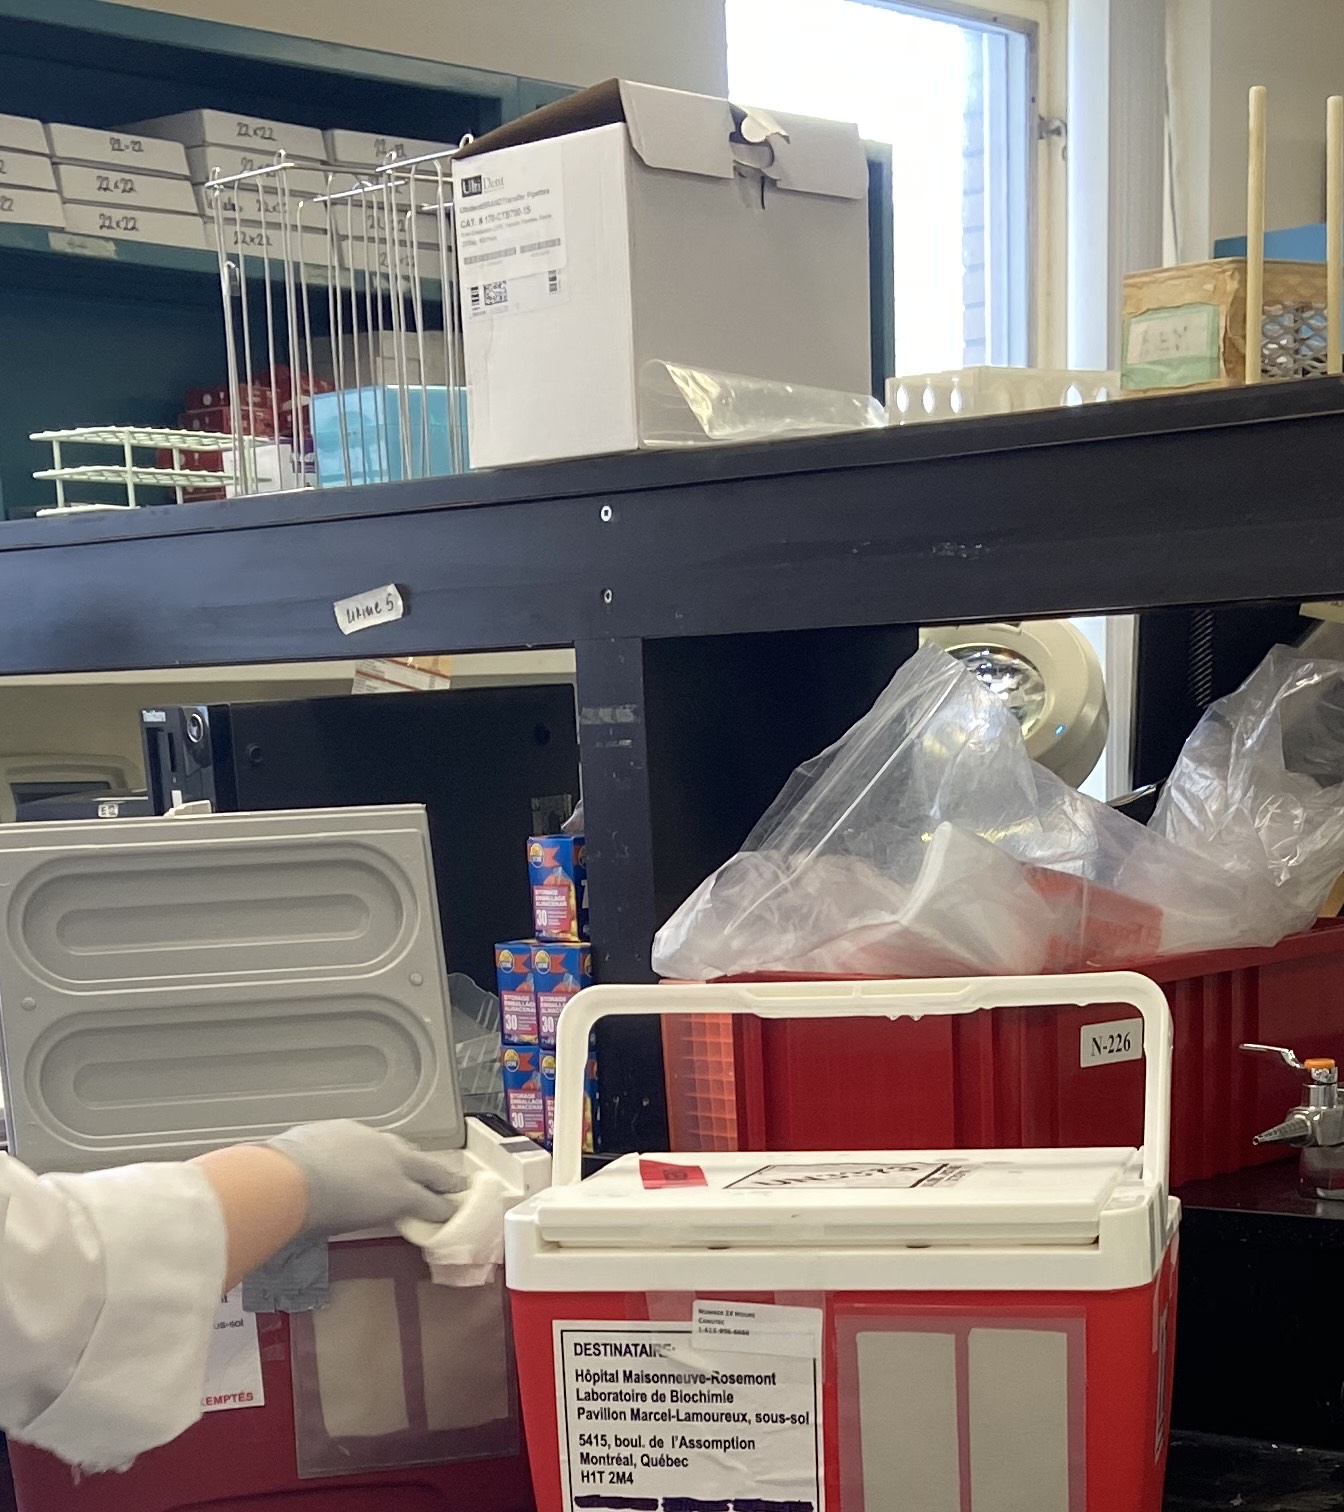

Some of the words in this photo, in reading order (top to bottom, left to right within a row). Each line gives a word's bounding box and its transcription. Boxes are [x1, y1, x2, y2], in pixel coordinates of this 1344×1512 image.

[1090, 1032, 1131, 1057] N-226
[575, 1368, 619, 1386] Hôpital
[622, 1370, 776, 1386] Maisonneuve-Rosemont
[576, 1387, 647, 1403] Laboratoire
[651, 1389, 666, 1403] de
[670, 1389, 734, 1404] Biochimie
[577, 1406, 627, 1421] Pavillon
[630, 1408, 751, 1425] Marcel-Lamoureux,
[755, 1411, 809, 1425] sous-sol
[579, 1433, 611, 1450] 5415,
[614, 1434, 645, 1448] boul.
[649, 1435, 664, 1449] de
[579, 1452, 637, 1469] Montréal,
[640, 1453, 689, 1468] Québec
[581, 1469, 605, 1484] H1T
[608, 1471, 634, 1485] 2M4
